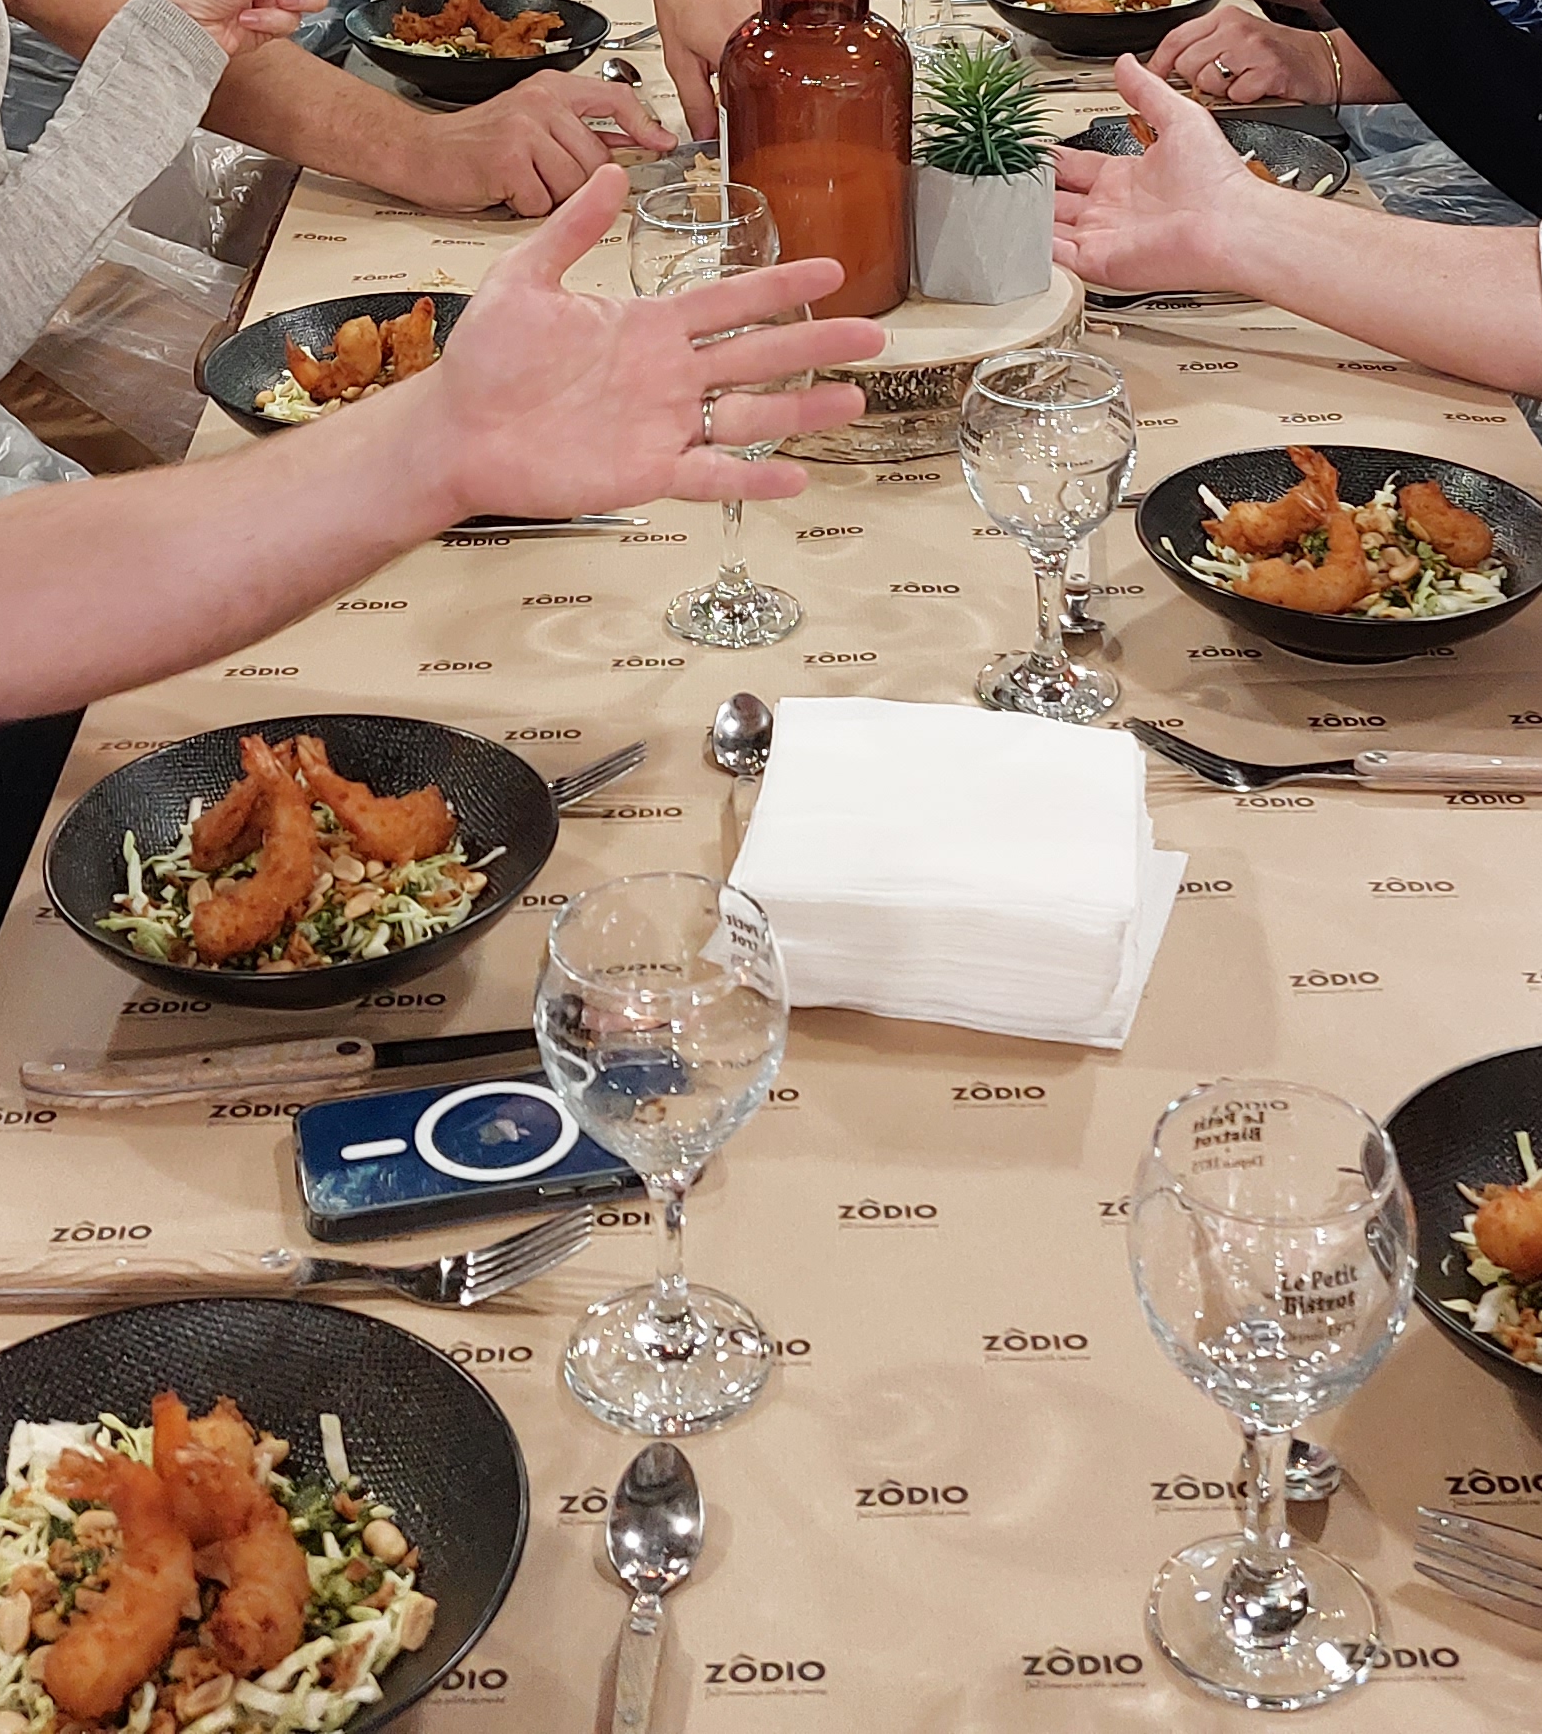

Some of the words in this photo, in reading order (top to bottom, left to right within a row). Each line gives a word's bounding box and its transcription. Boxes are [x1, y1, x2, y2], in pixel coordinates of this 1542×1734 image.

[796, 526, 863, 539] ZÔDIO
[890, 582, 959, 594] ZÔDIO
[1091, 585, 1143, 595] ÔDIO
[336, 599, 408, 610] ZÔDIO
[804, 652, 877, 663] ZÔDIO
[225, 666, 298, 677] ZÔDIO
[1307, 711, 1387, 727] ZÔDIO
[1236, 793, 1313, 809] ZÔDIO
[1445, 792, 1525, 807] ZÔDIO
[603, 805, 682, 818] ZÔDIO
[1178, 878, 1232, 894] DIO
[1369, 877, 1455, 894] ZÔDIO
[523, 895, 569, 907] DIO
[1291, 968, 1379, 989] ZÔDIO
[121, 997, 211, 1015] ZÔDIO
[953, 1082, 1045, 1102] ZÔDIO
[596, 1207, 653, 1227] ÔDI
[839, 1198, 936, 1221] ZÔDIO
[51, 1221, 152, 1244] ZÔDIO
[982, 1328, 1088, 1353] ZÔDIO
[442, 1343, 533, 1365] ÔDIO
[856, 1478, 969, 1507] ZÔDIO
[706, 1655, 825, 1684] ZÔDIO
[1023, 1647, 1143, 1675] ZÔDIO
[441, 1669, 508, 1691] DIO
